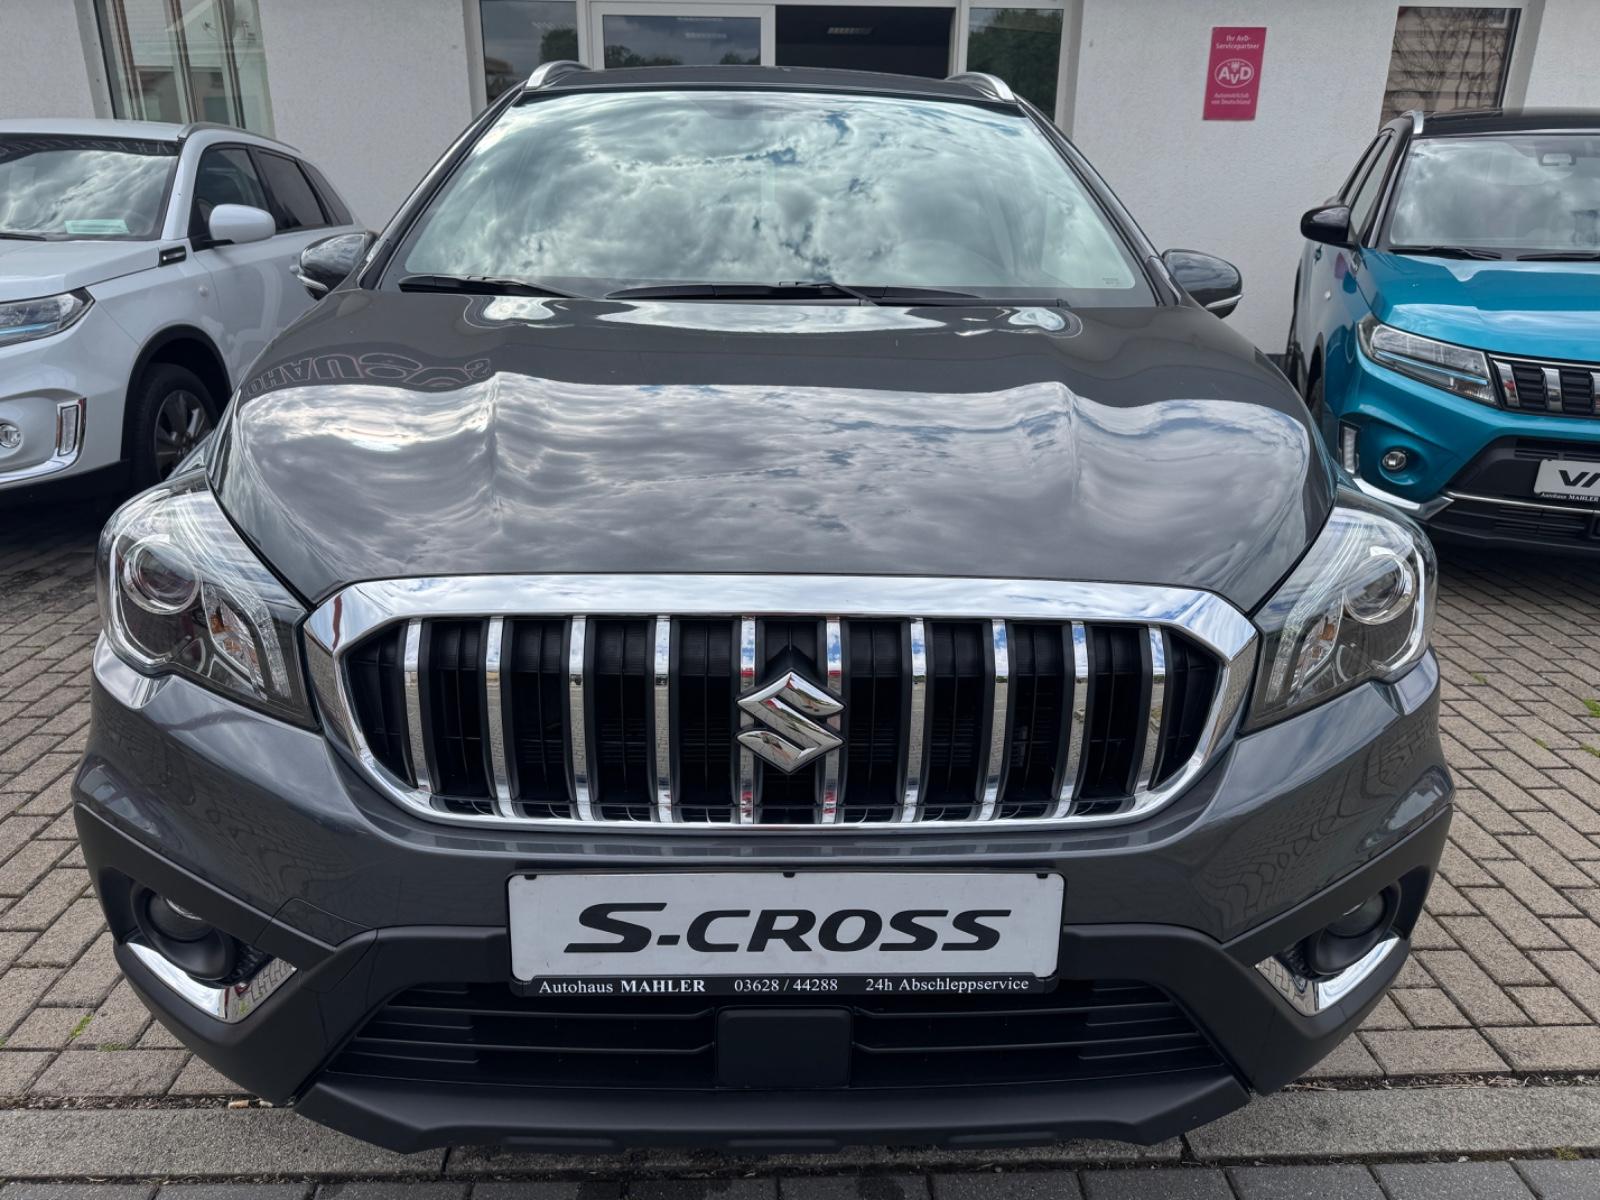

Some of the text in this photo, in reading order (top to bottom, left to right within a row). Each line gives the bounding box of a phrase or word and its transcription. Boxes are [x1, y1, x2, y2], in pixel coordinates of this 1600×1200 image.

[1218, 66, 1252, 84] AvD
[563, 902, 1012, 954] S-CROSS
[539, 980, 614, 994] Autohaus
[621, 979, 706, 993] MAHLER
[865, 978, 893, 991] 24h
[899, 977, 1029, 994] Abschleppservice
